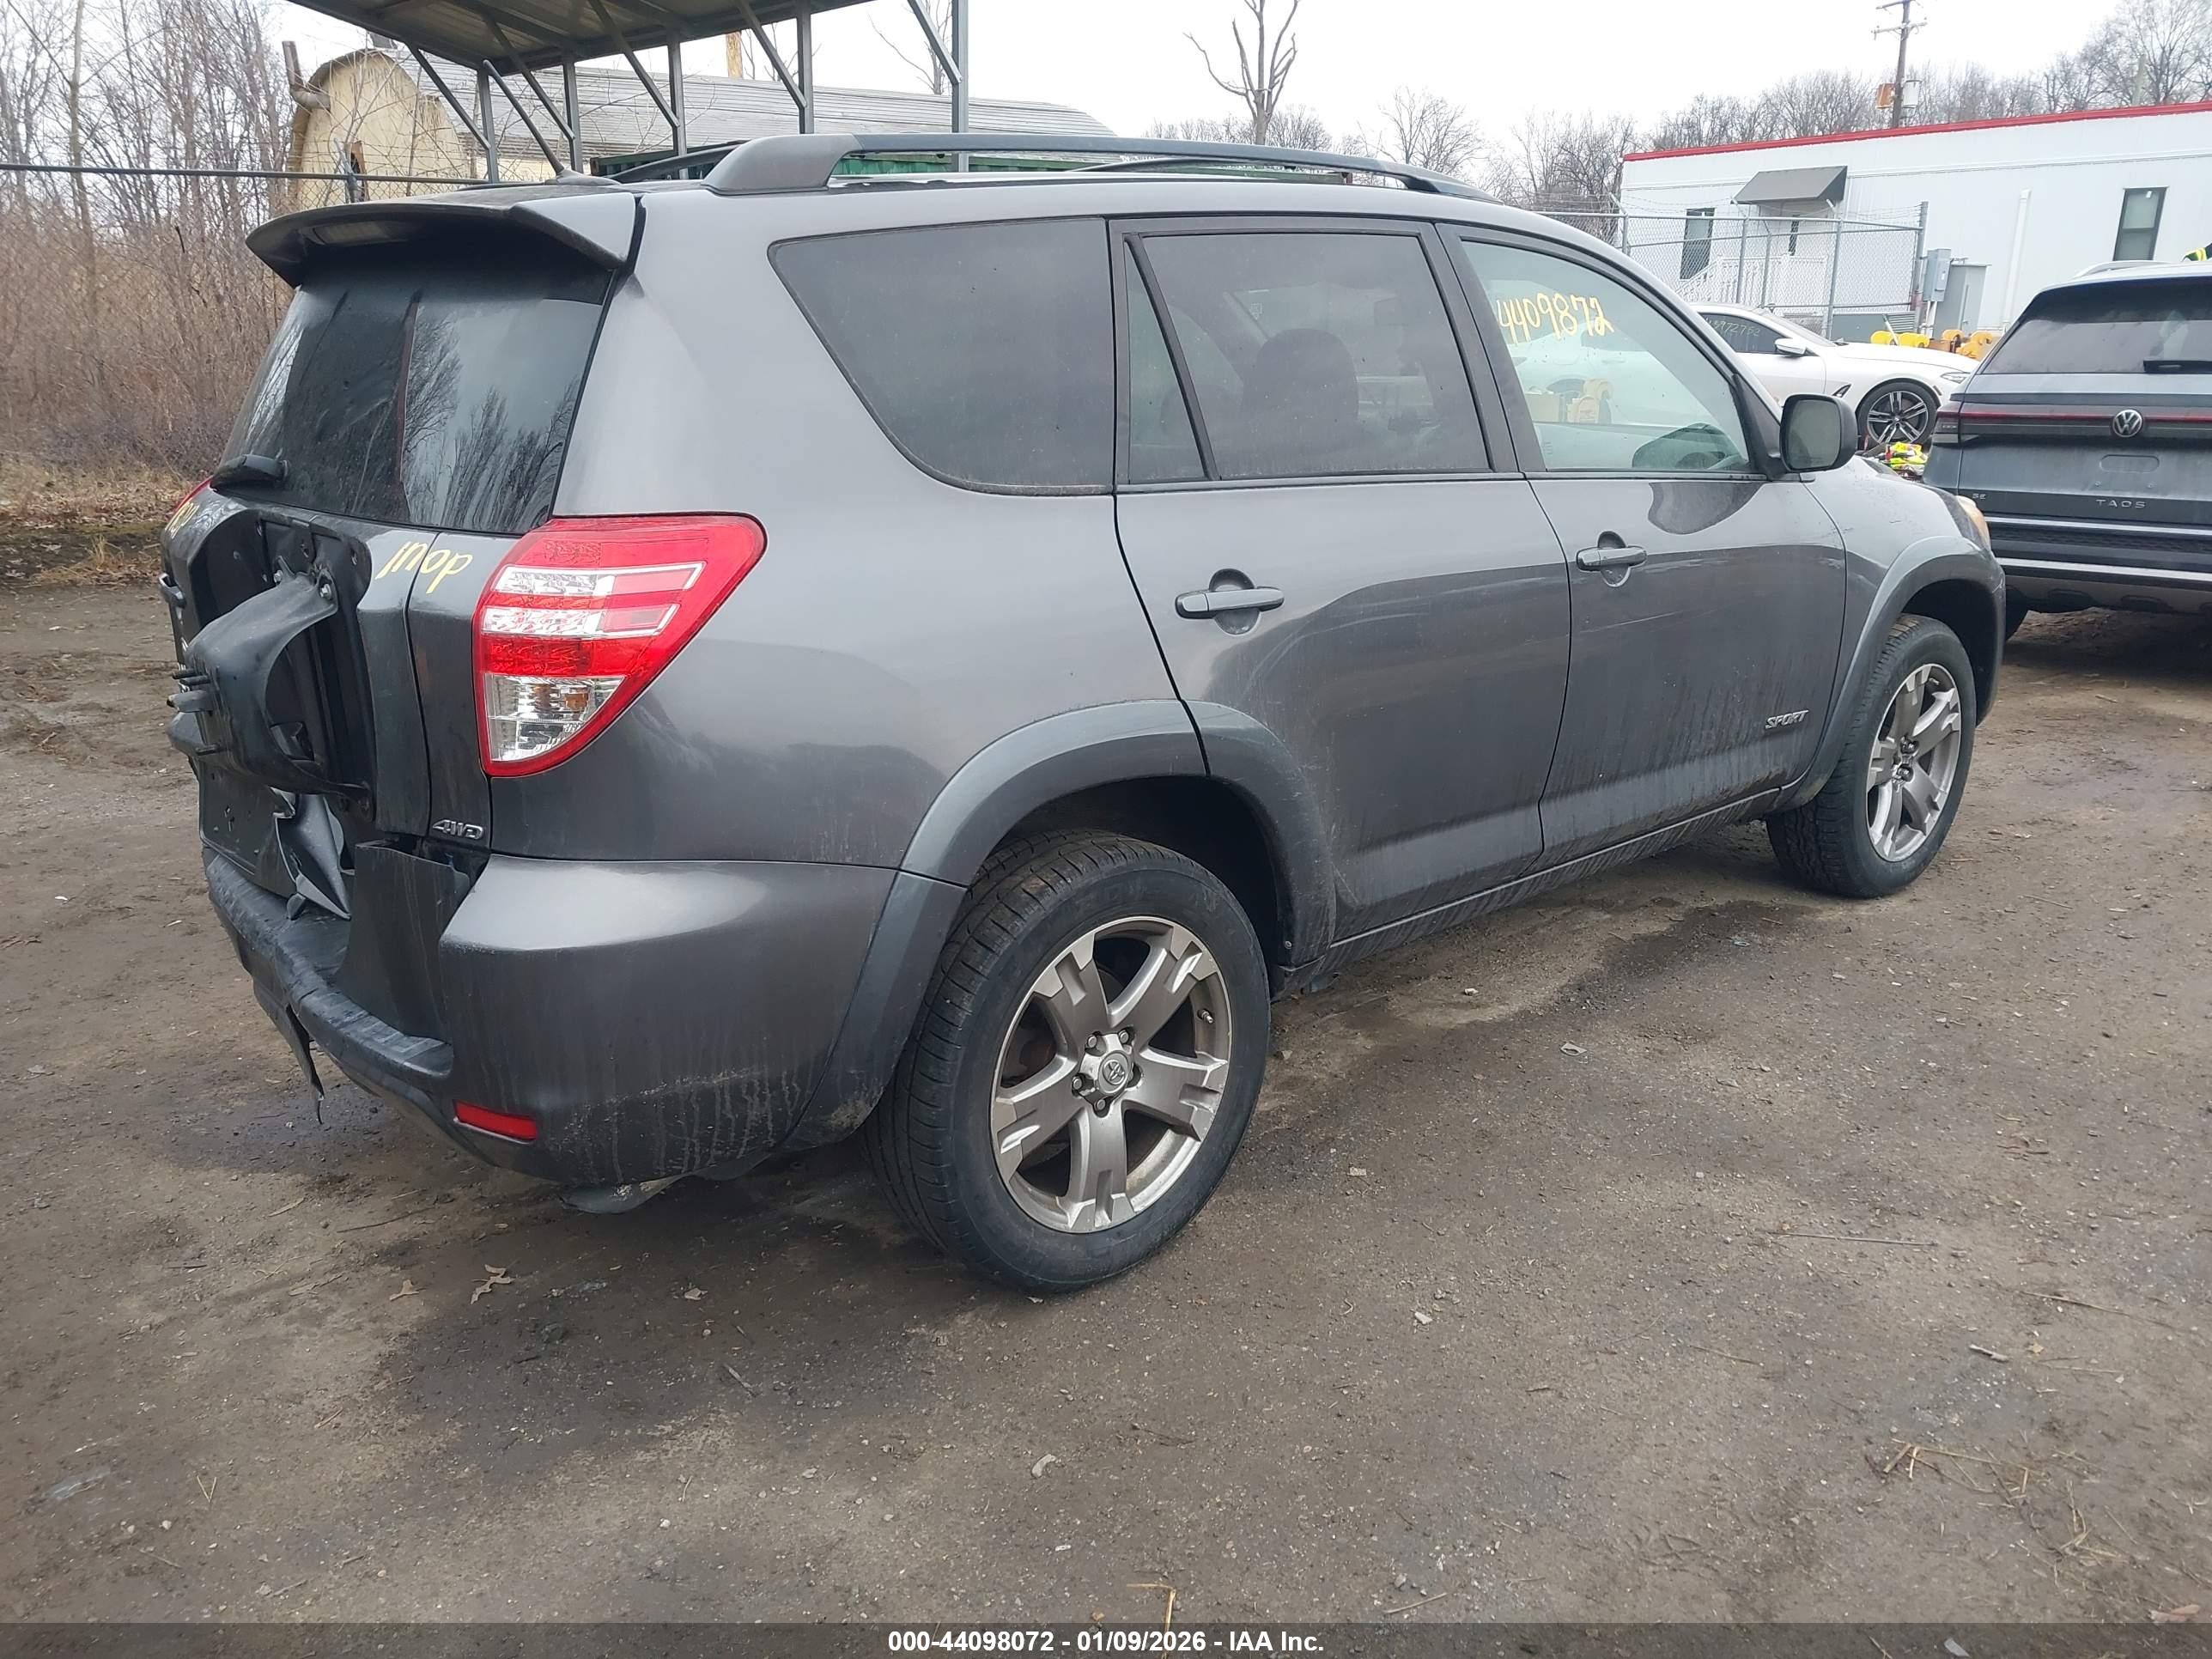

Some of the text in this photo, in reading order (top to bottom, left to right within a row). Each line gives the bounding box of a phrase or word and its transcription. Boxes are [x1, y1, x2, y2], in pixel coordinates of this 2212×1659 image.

[1497, 293, 1614, 343] 4409872
[2096, 499, 2147, 508] TAOS
[1765, 709, 1809, 729] SPORT
[432, 819, 483, 840] 4WD
